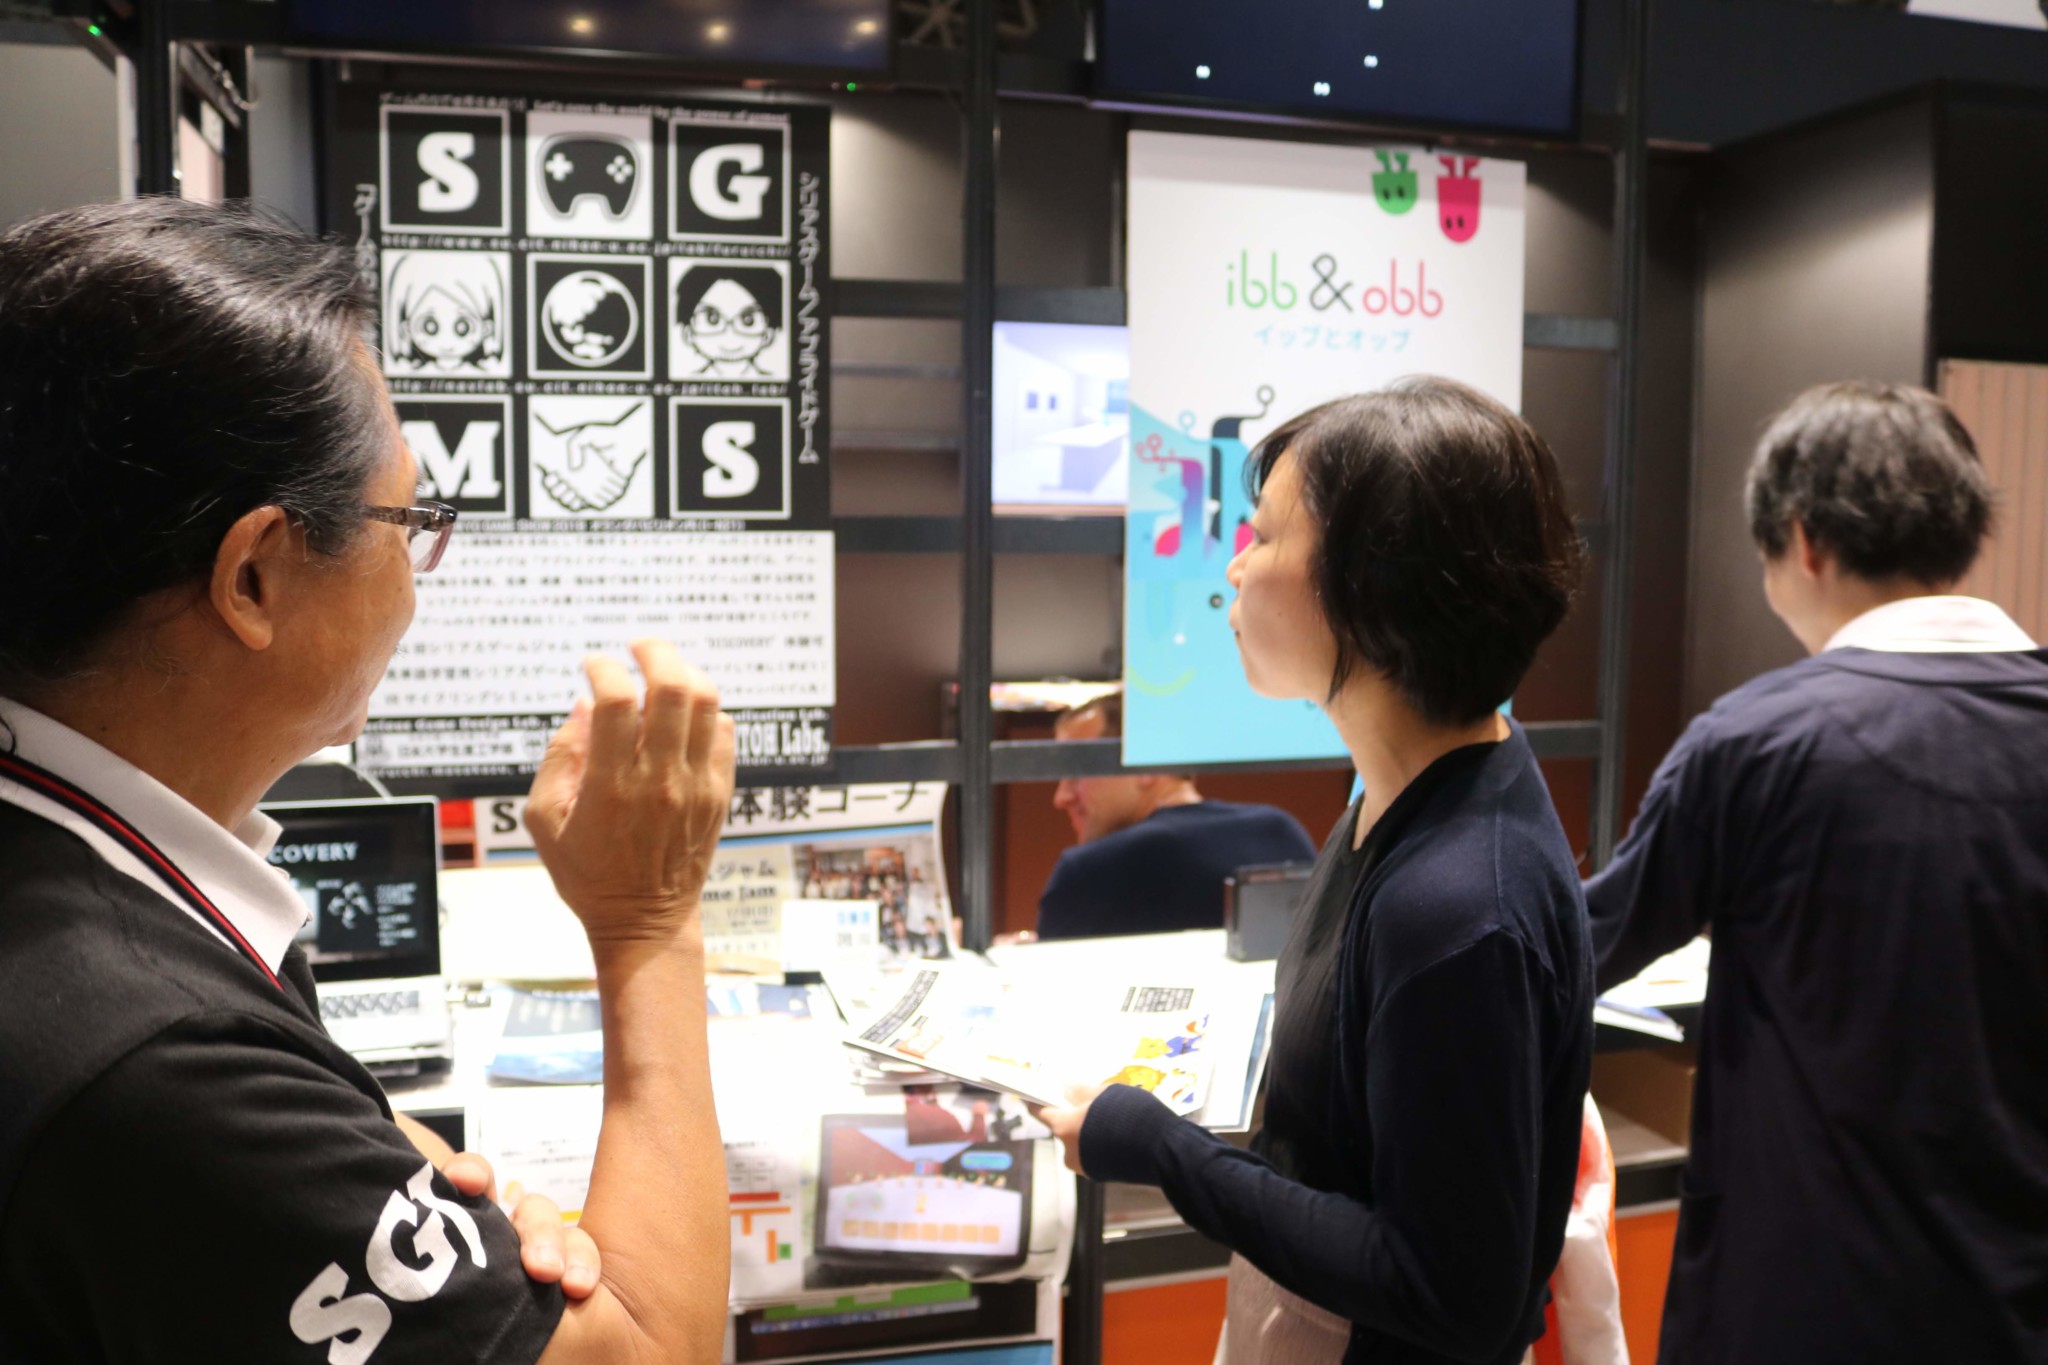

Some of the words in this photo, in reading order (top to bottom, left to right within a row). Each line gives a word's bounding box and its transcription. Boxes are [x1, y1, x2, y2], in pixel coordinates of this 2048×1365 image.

[417, 132, 479, 213] S
[690, 143, 771, 220] G
[1227, 249, 1298, 310] ibb
[1310, 254, 1354, 313] &
[1363, 258, 1444, 318] obb
[402, 420, 502, 498] M
[701, 421, 760, 498] S
[268, 842, 358, 864] COVERY
